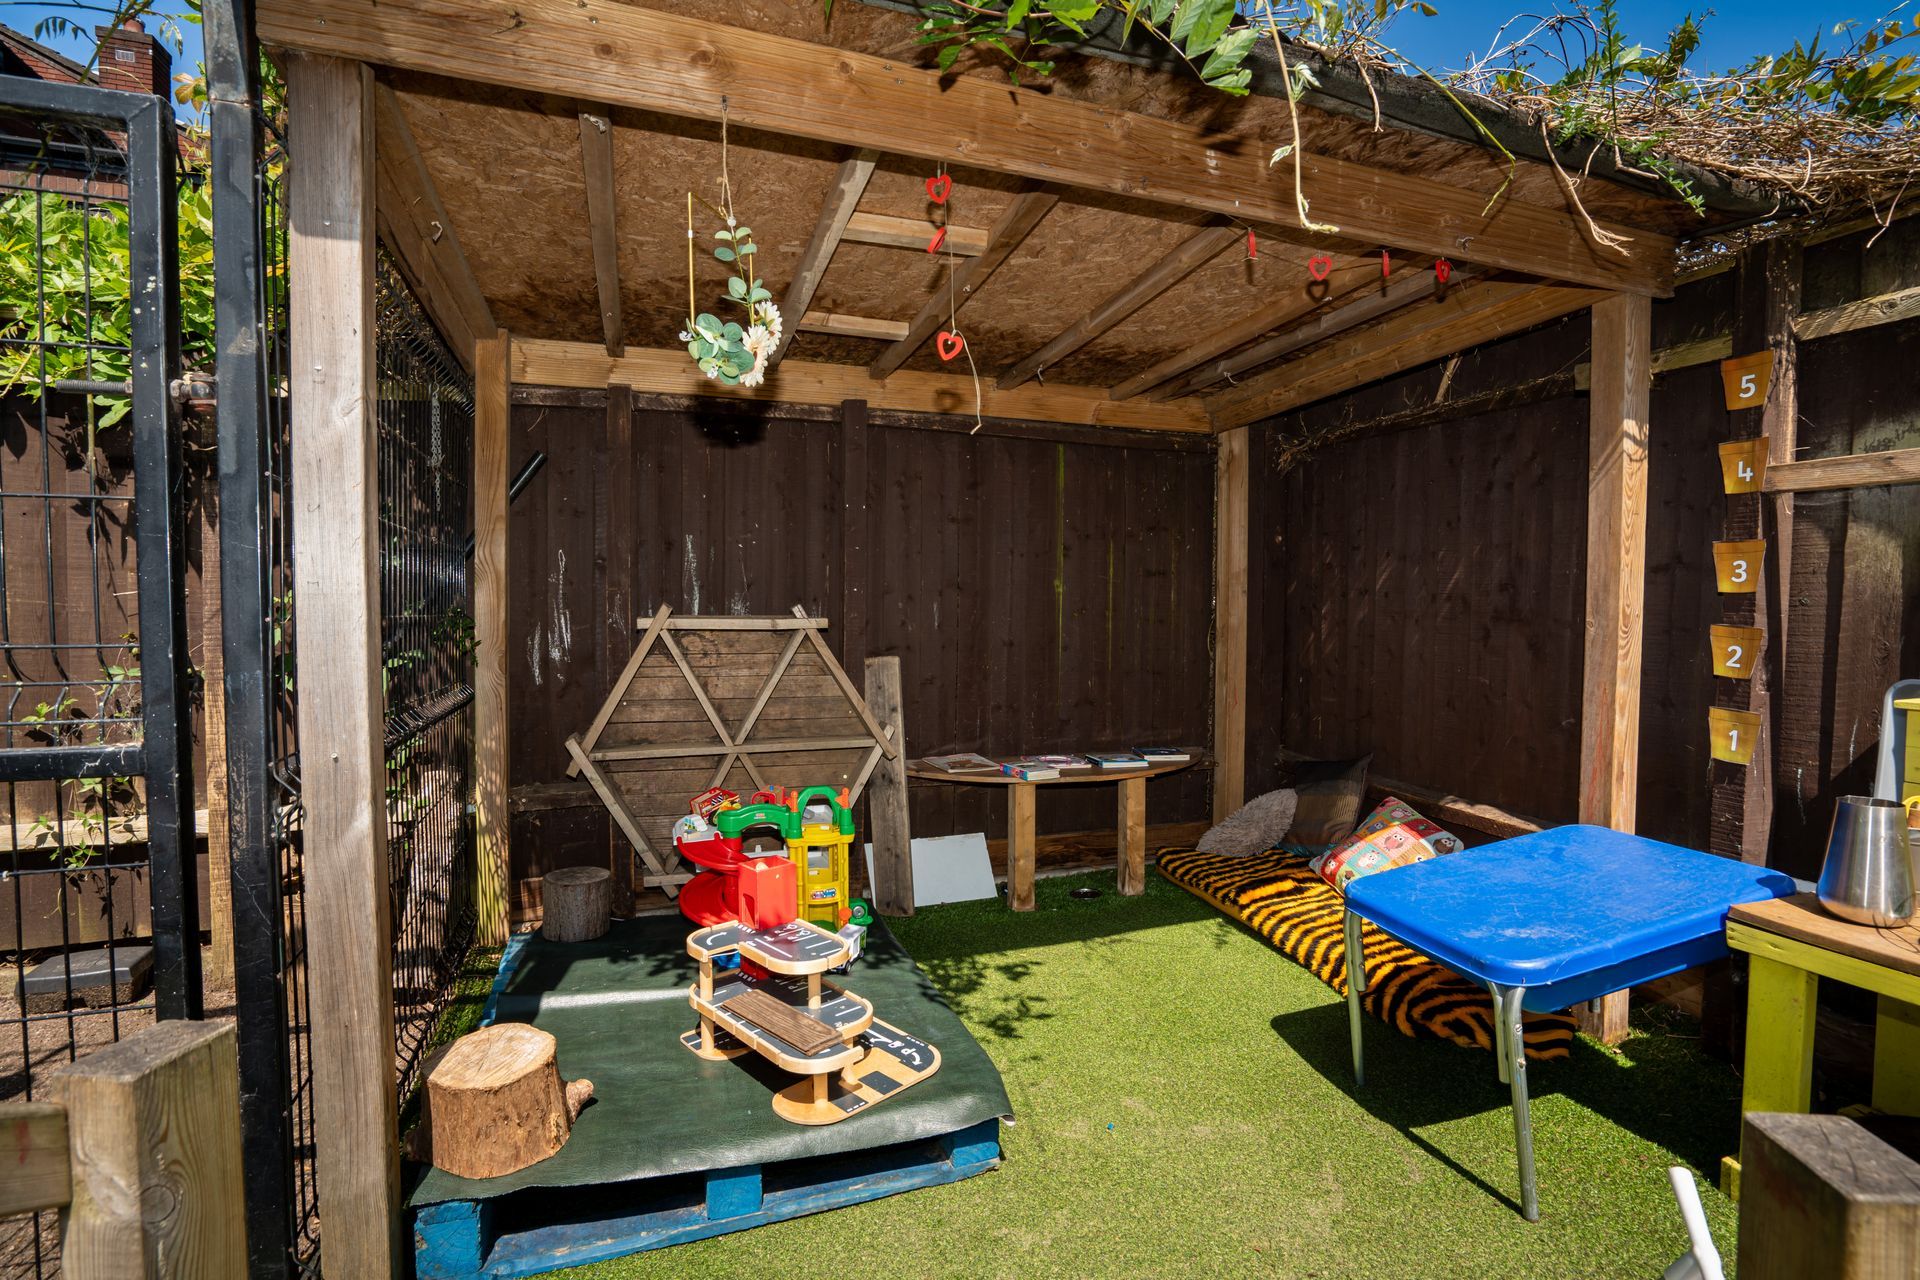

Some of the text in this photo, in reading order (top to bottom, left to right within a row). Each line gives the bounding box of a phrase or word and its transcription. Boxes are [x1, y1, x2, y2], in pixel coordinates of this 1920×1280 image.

[1739, 374, 1756, 398] 5
[1738, 461, 1754, 482] 4
[1731, 560, 1747, 583] 3
[1725, 645, 1742, 668] 2
[1728, 729, 1738, 752] 1
